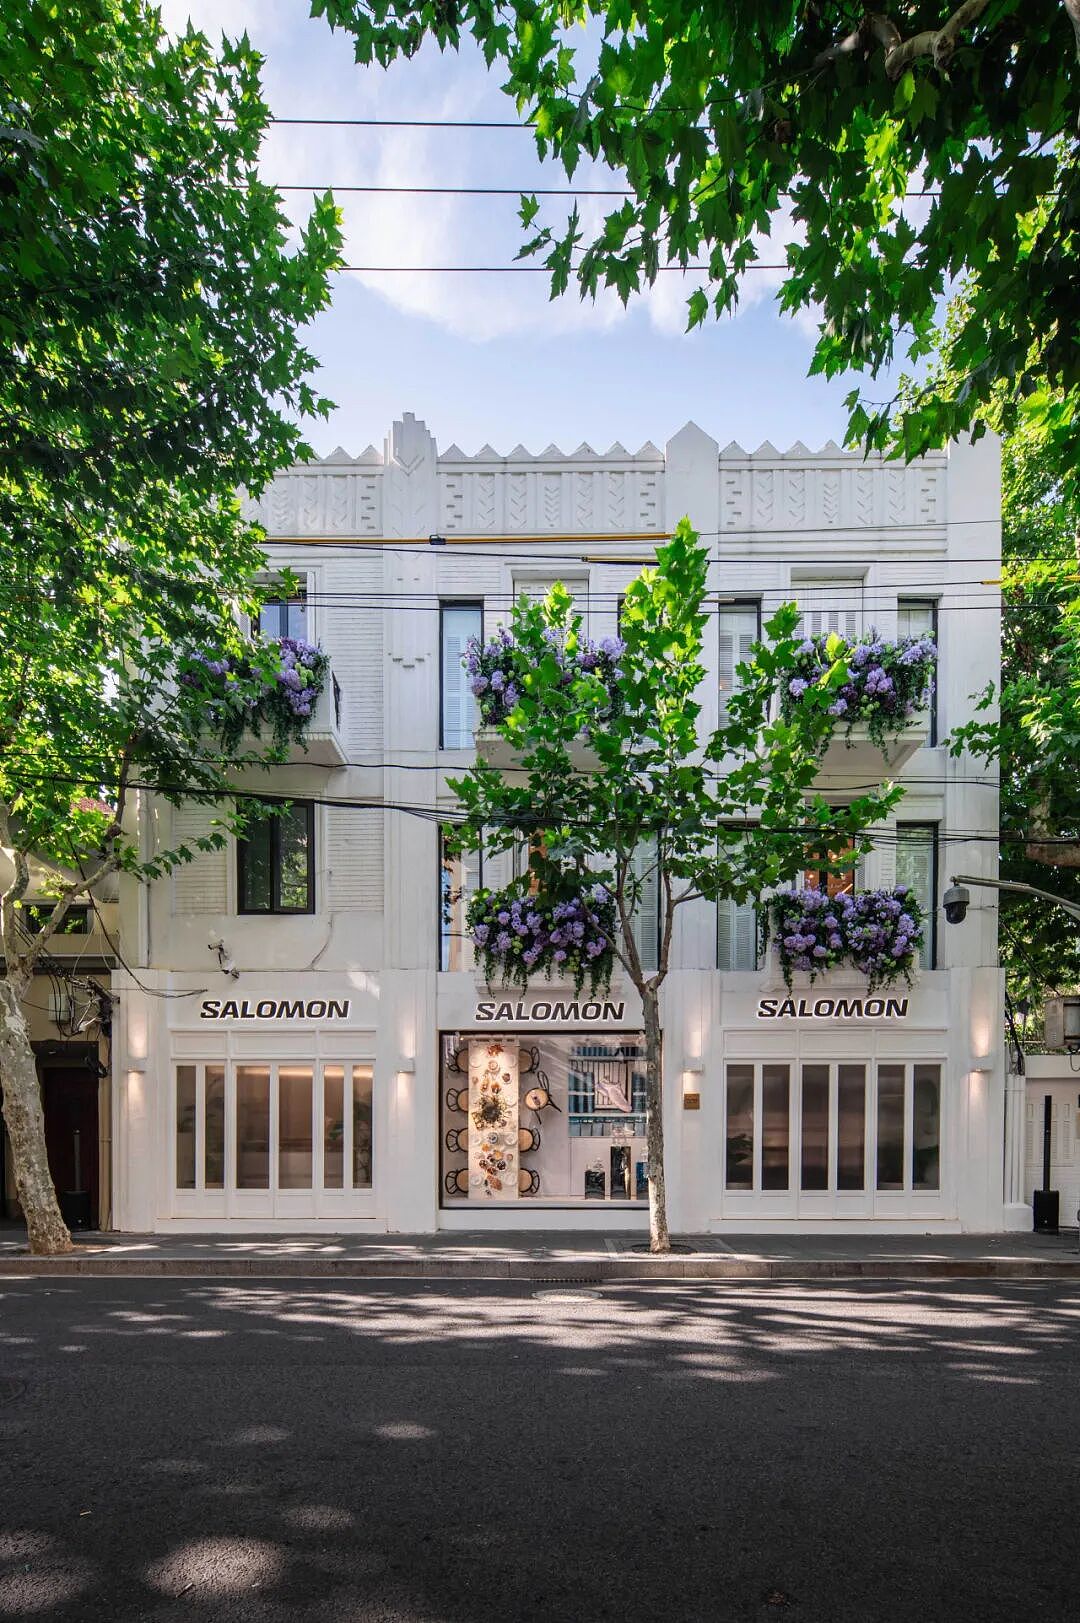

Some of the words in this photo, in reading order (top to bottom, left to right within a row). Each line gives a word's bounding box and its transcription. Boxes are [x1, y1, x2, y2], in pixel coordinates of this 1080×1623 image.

[200, 1000, 350, 1019] SALOMON
[475, 1002, 625, 1021] SALOMON
[757, 999, 909, 1018] SALOMON
